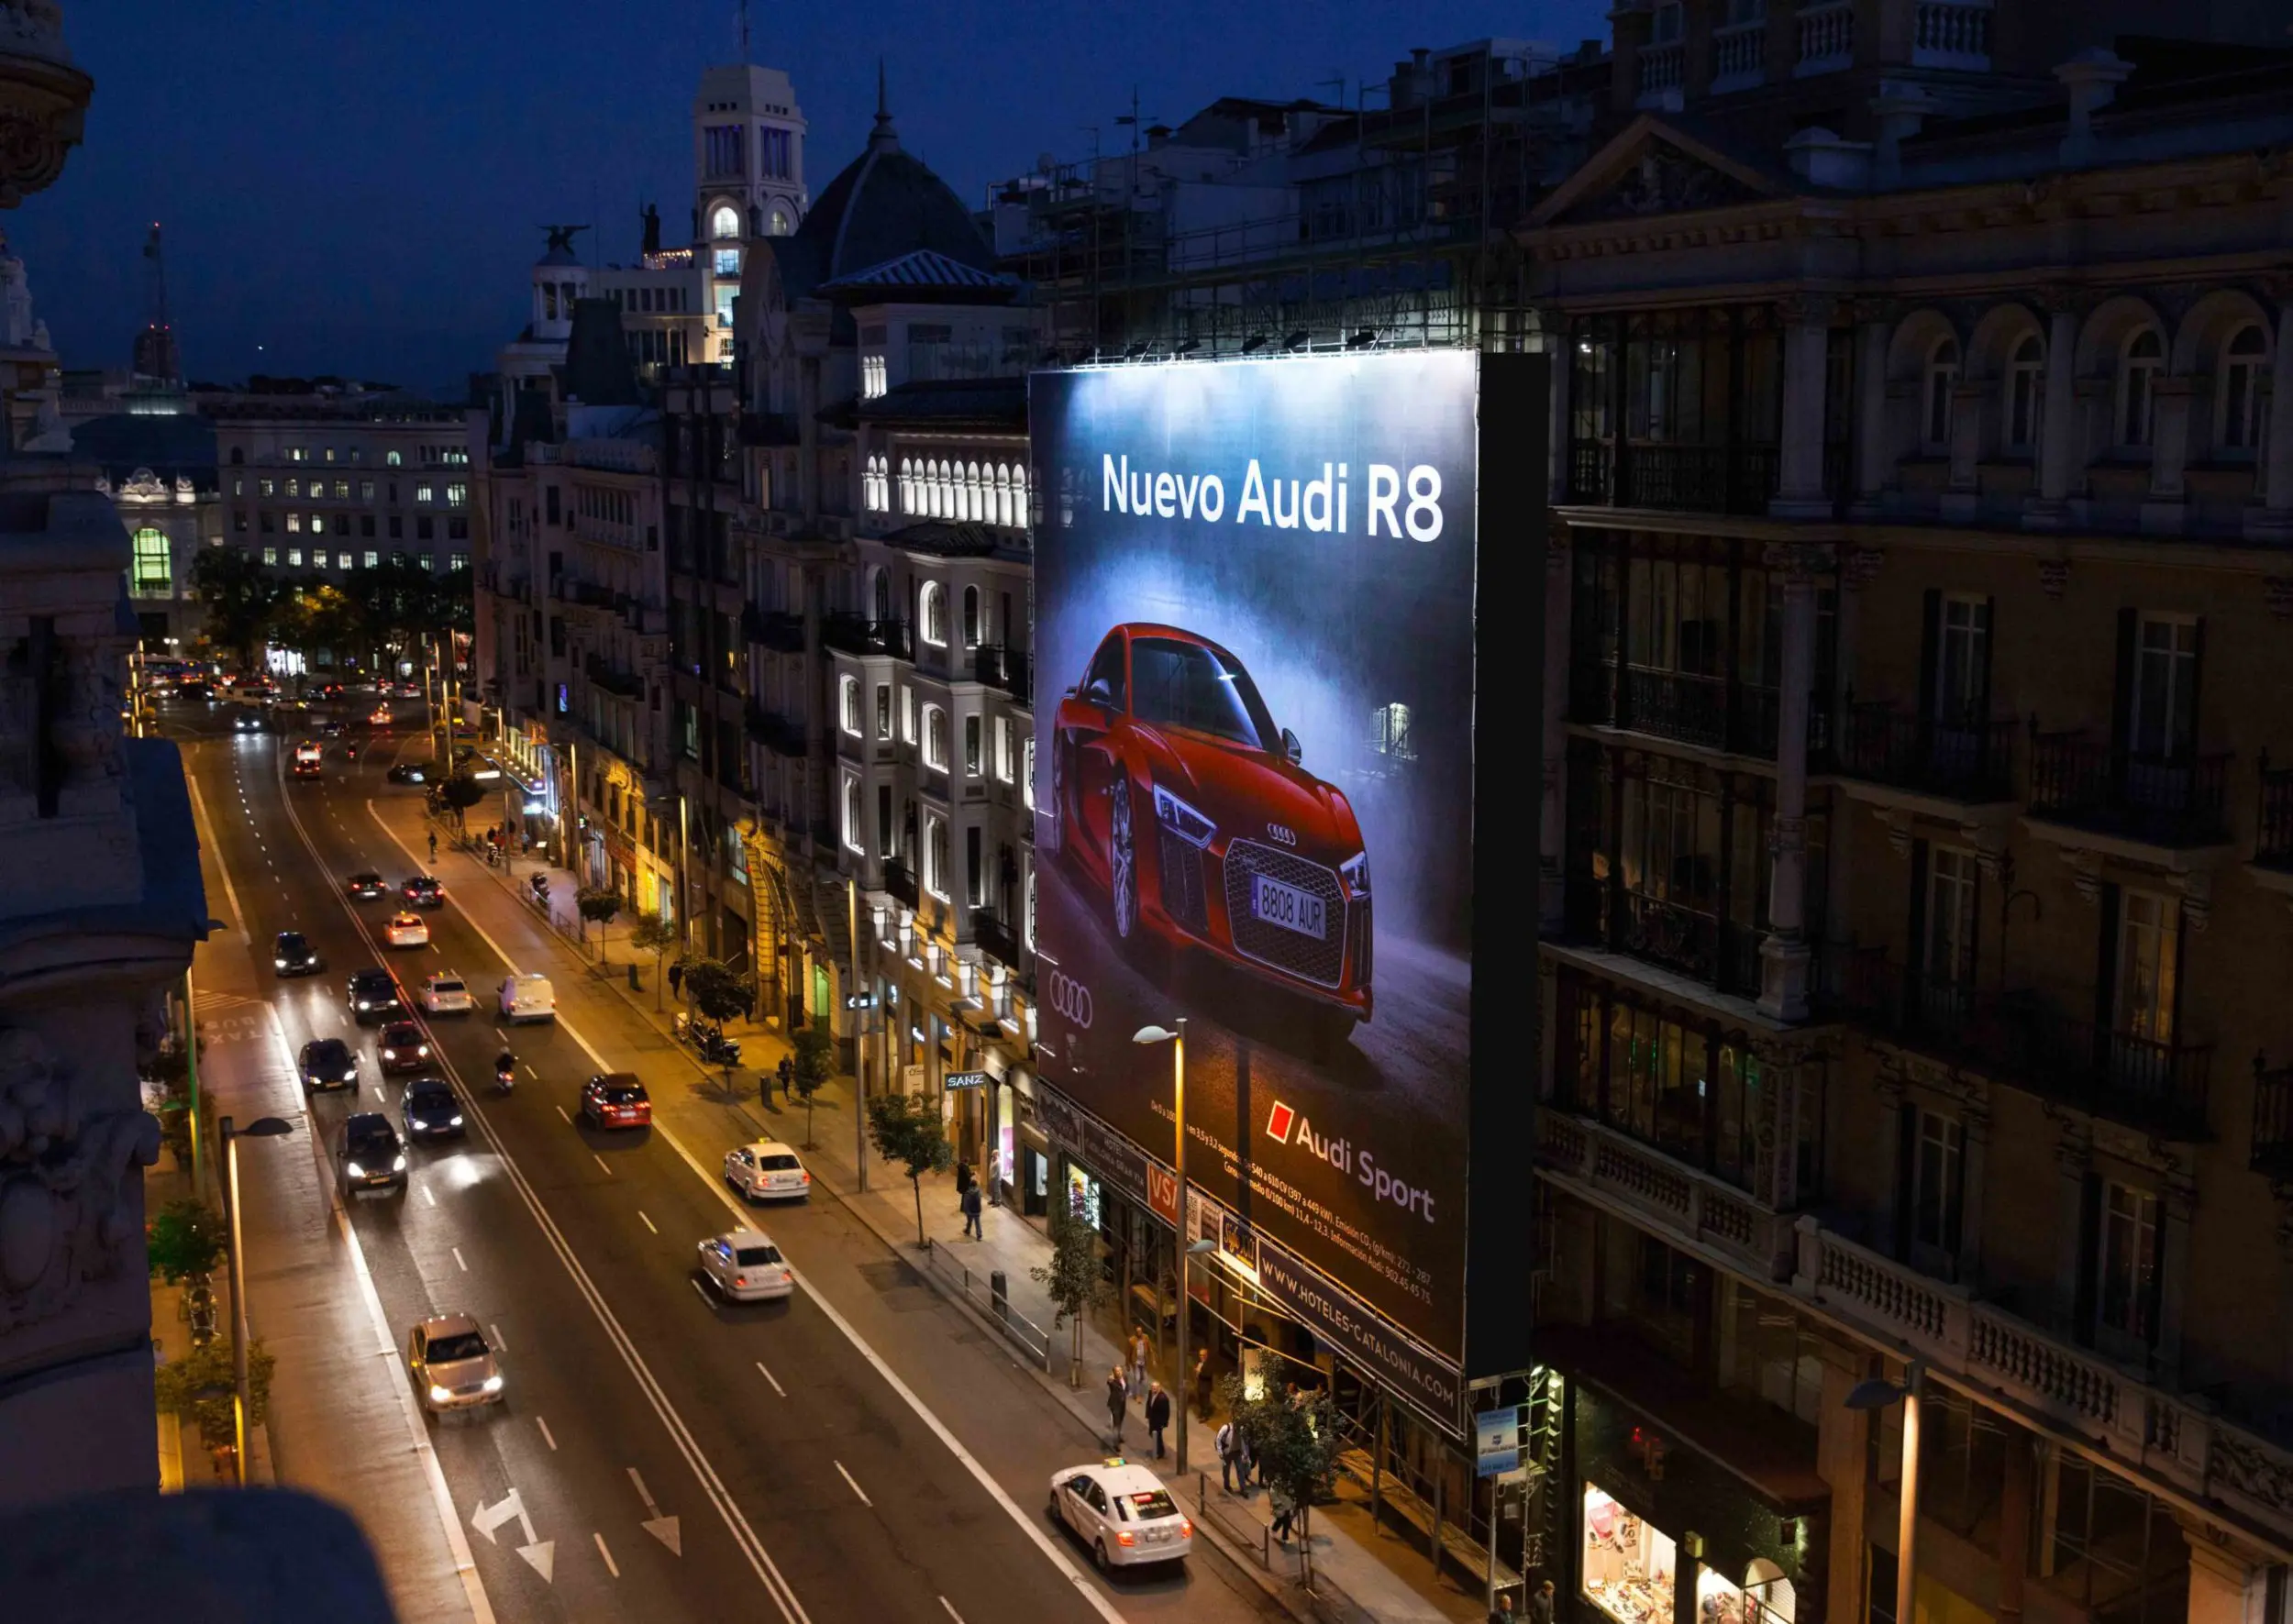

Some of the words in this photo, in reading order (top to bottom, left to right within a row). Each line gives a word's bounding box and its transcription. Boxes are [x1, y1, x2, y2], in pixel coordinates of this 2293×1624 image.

[1102, 453, 1224, 523] Nuevo
[1236, 458, 1348, 534] Audi
[1368, 463, 1444, 543] R8
[1262, 884, 1294, 923] 8808
[1298, 896, 1322, 934] AUR
[947, 1074, 985, 1087] SANZ
[1296, 1116, 1351, 1175] Audi
[1358, 1150, 1435, 1223] Sport
[1251, 1163, 1263, 1179] 540
[1268, 1173, 1279, 1189] 610
[1279, 1181, 1288, 1194] CV
[1287, 1186, 1302, 1203] (397
[1397, 1255, 1411, 1275] 272
[1262, 1257, 1454, 1409] WWW.HOTELES-CATALONIA.COM
[1410, 1283, 1420, 1298] 45
